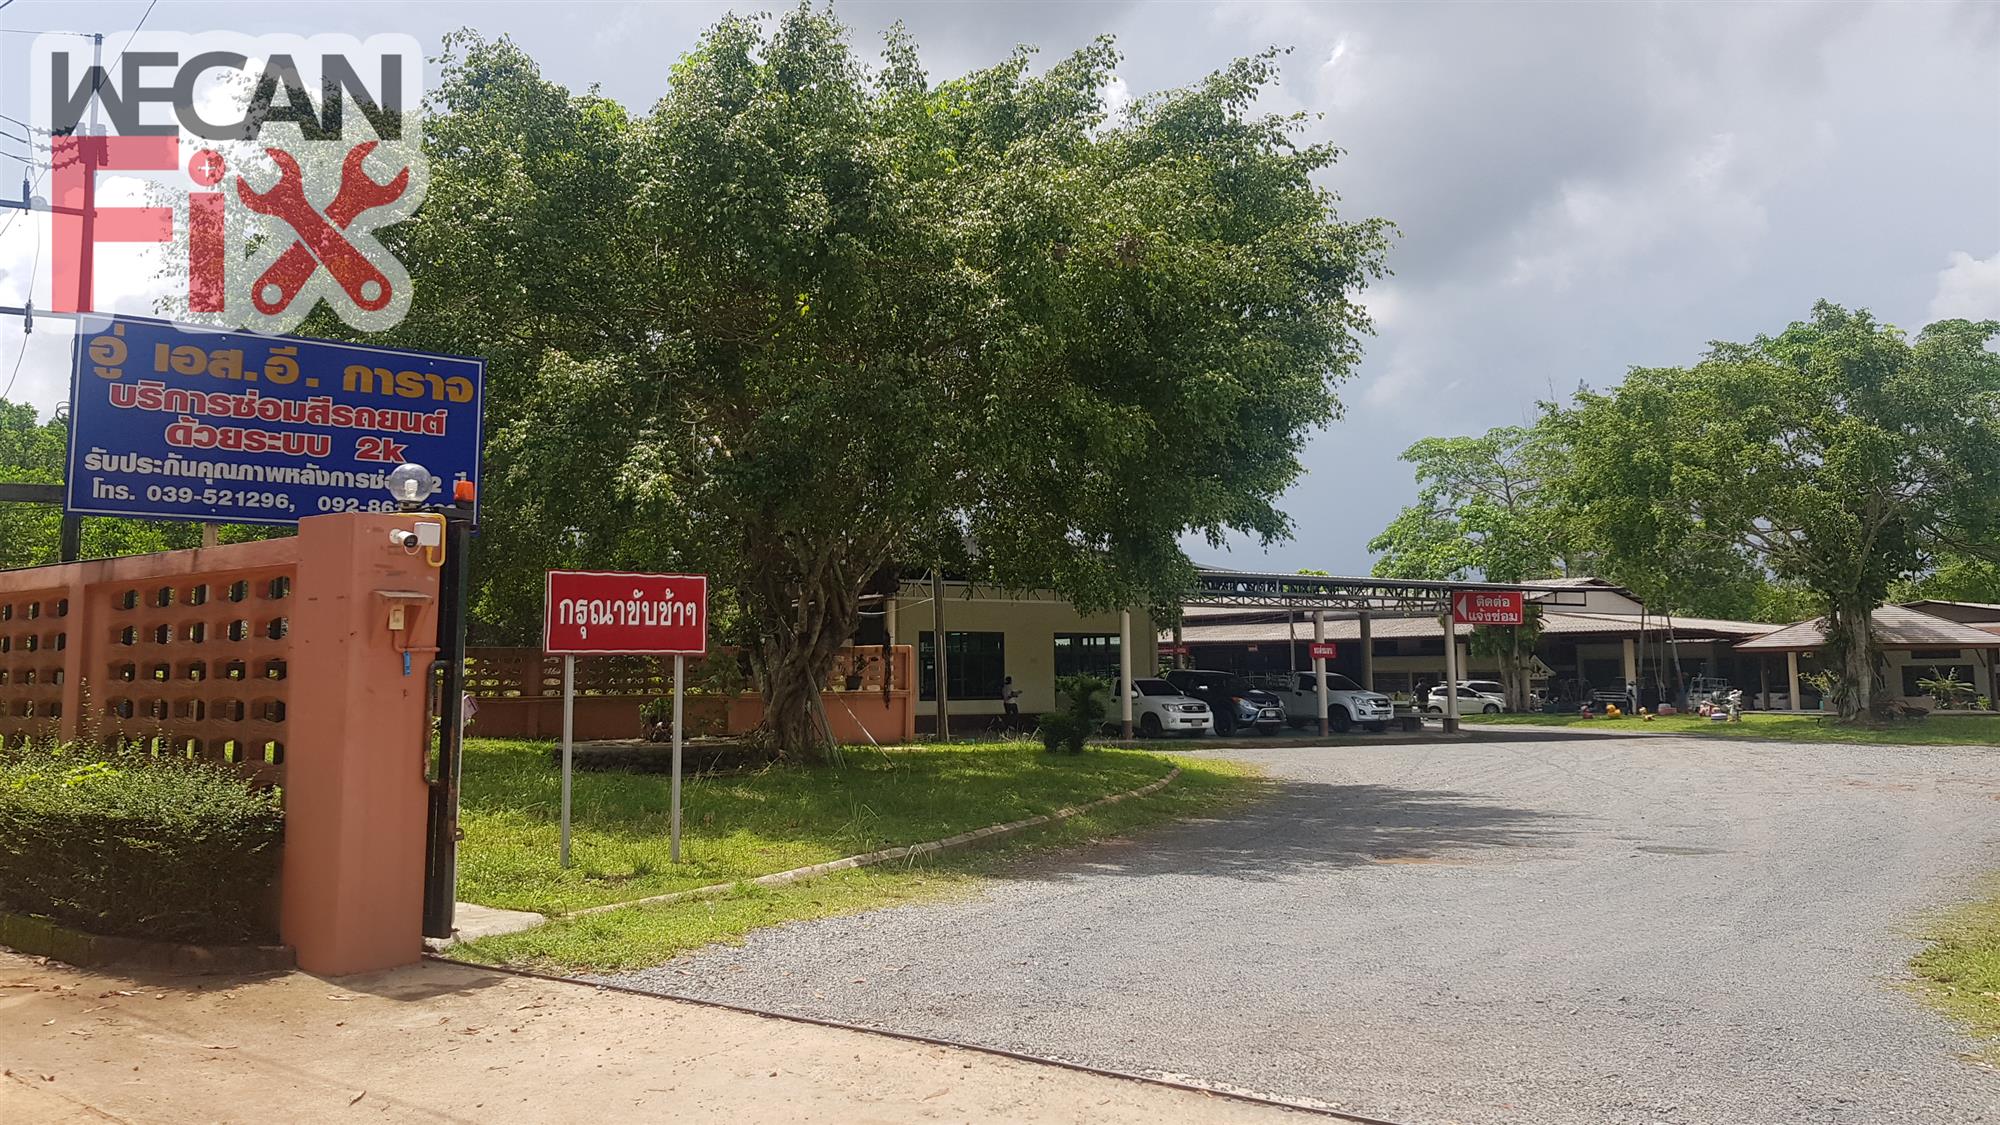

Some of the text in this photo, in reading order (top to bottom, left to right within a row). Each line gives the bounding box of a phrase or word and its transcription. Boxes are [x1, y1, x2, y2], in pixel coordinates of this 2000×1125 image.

[89, 324, 128, 379] อู่
[343, 365, 474, 403] การาจ
[109, 379, 448, 437] บริการซ่อมสีรถยนต์
[165, 415, 408, 463] ด้วยระบบ 2k
[92, 477, 136, 501] โทร.
[146, 485, 296, 512] 039-521296,
[559, 588, 697, 639] กรุณาขับช้าๆ
[1468, 607, 1518, 622] แจ้งซ่อม
[1475, 594, 1510, 608] ติดต่อ
